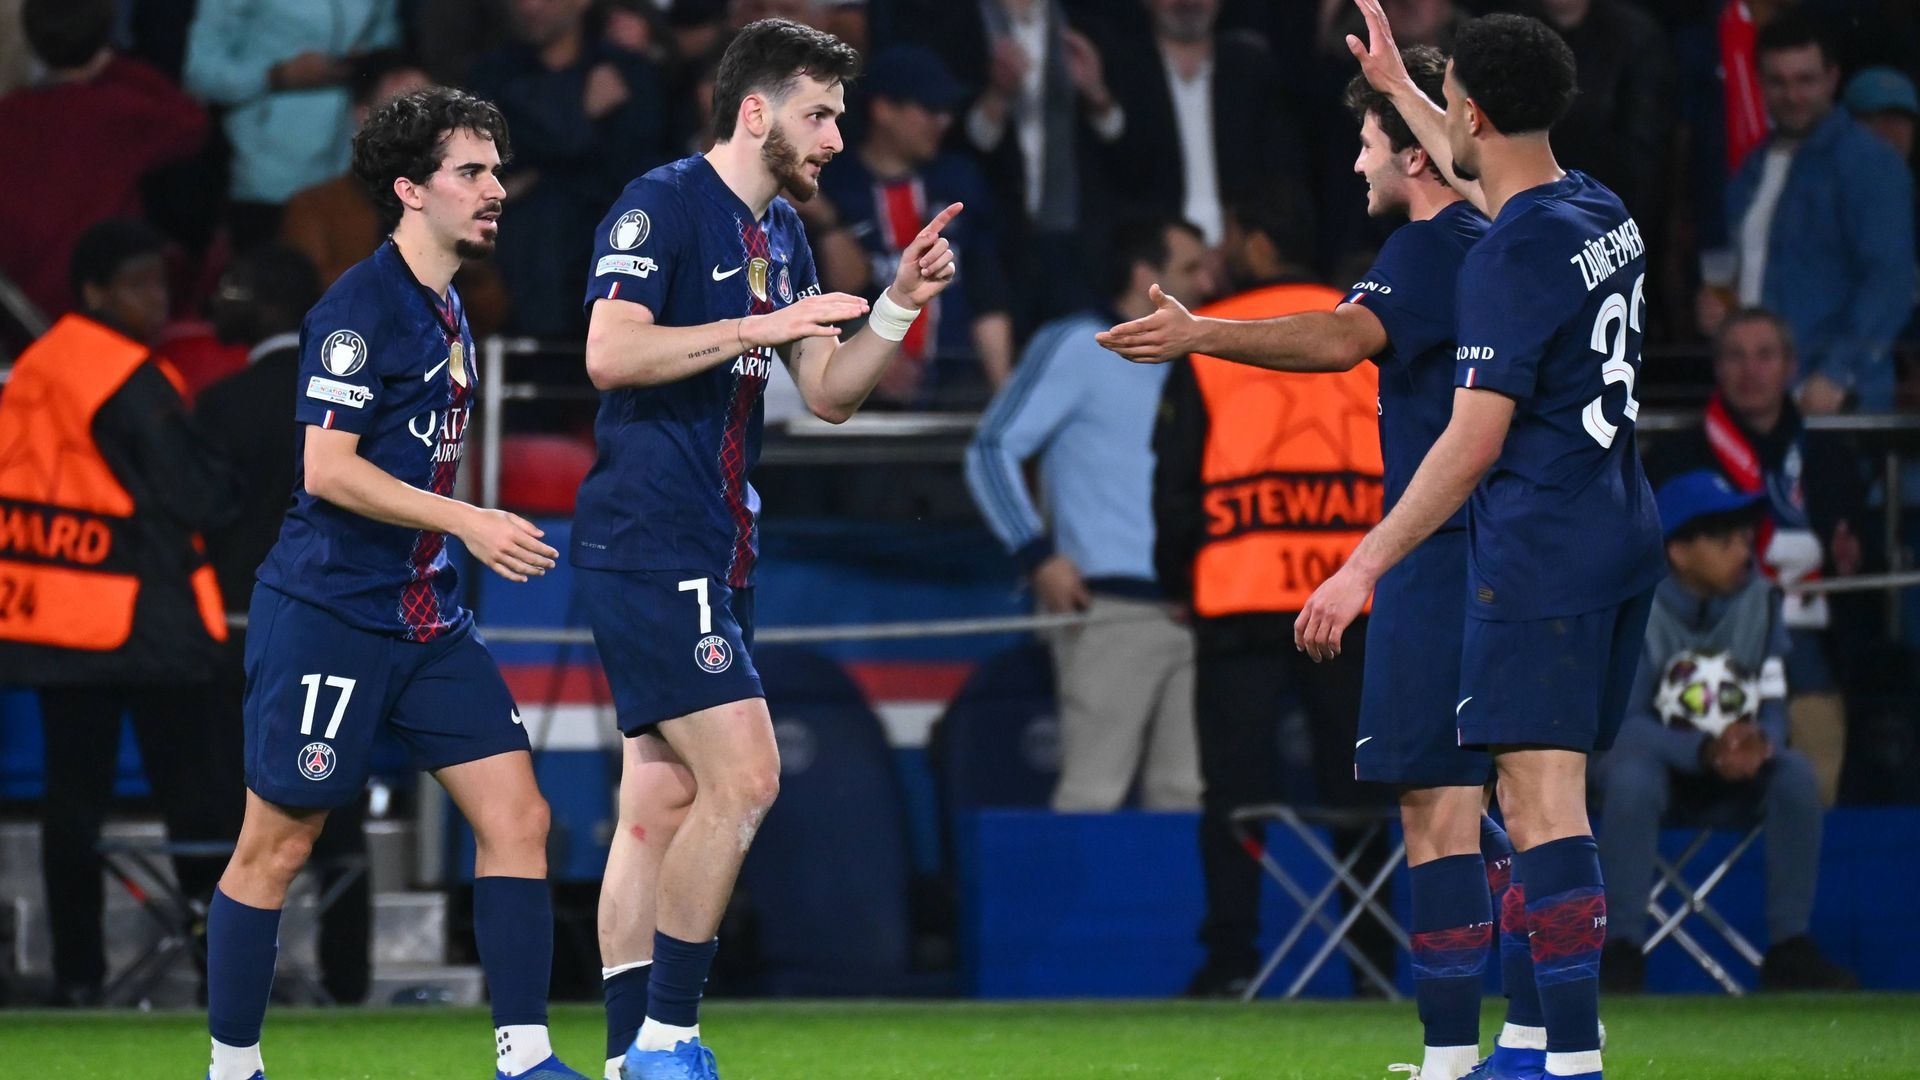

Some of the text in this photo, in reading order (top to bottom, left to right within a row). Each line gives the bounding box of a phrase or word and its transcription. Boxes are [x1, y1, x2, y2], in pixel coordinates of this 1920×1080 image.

[678, 578, 712, 634] 7
[699, 637, 724, 650] PARIS
[300, 673, 357, 739] 17
[306, 744, 332, 756] PARIS
